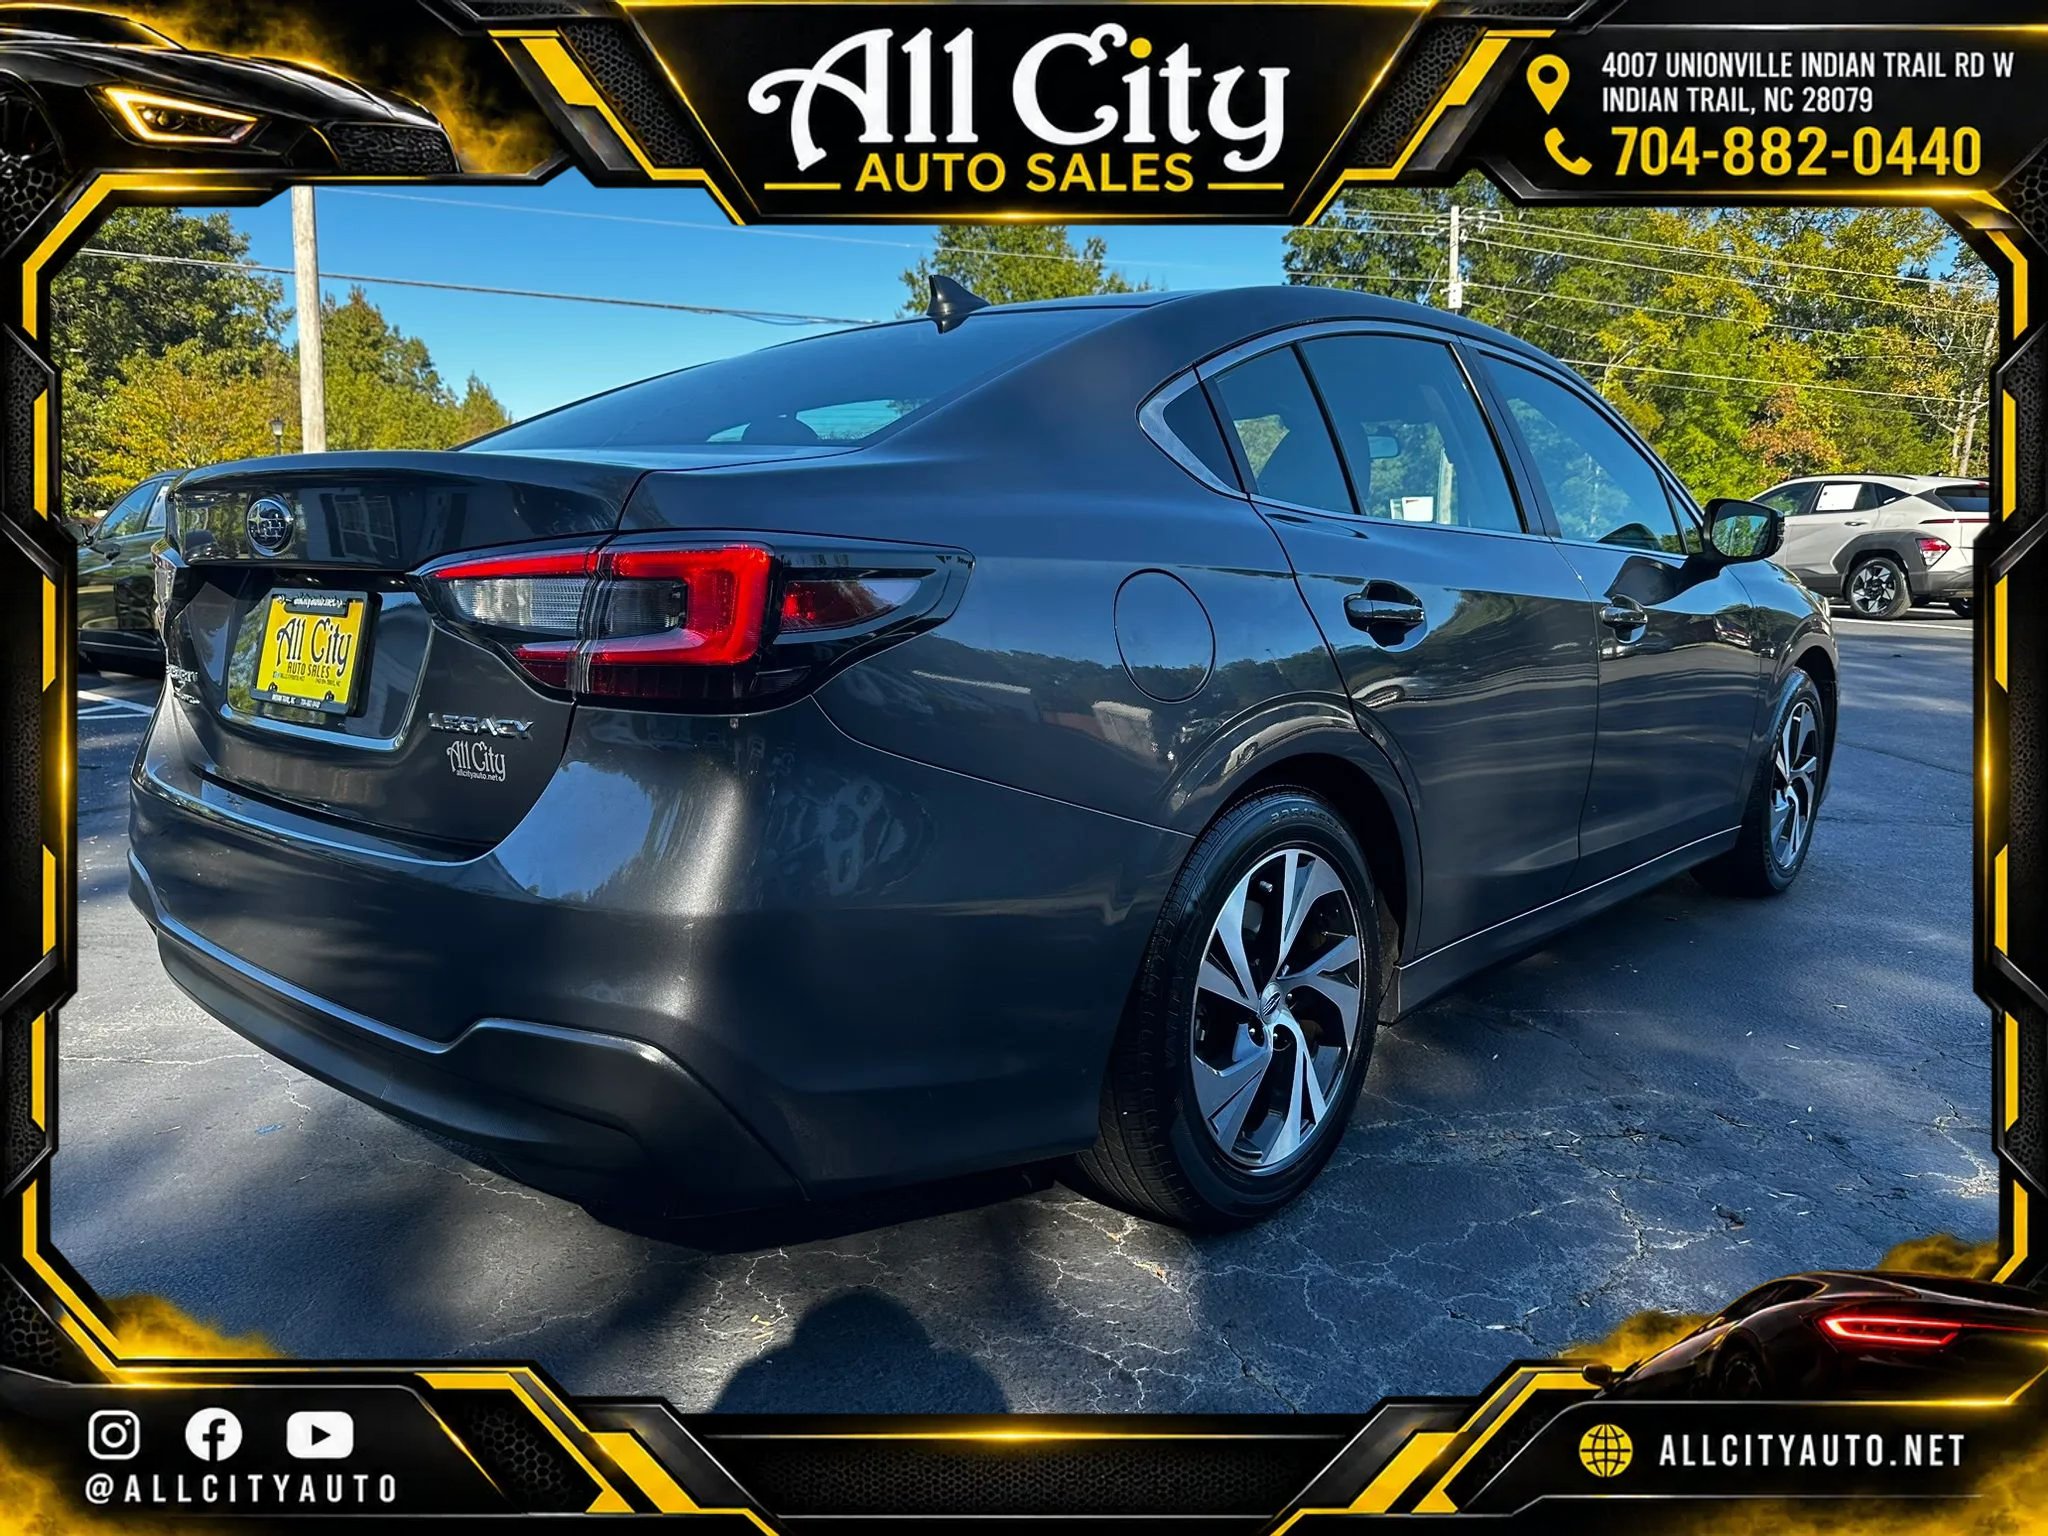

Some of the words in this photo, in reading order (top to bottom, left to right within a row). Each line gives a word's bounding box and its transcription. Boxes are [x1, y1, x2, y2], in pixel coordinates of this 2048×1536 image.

[277, 618, 306, 666] All
[311, 617, 351, 677] City
[287, 661, 306, 675] AUTO
[307, 664, 331, 679] SALES
[428, 712, 534, 738] LEGACY
[446, 740, 471, 772] All
[471, 740, 505, 782] City
[456, 769, 499, 781] allcityauto.net
